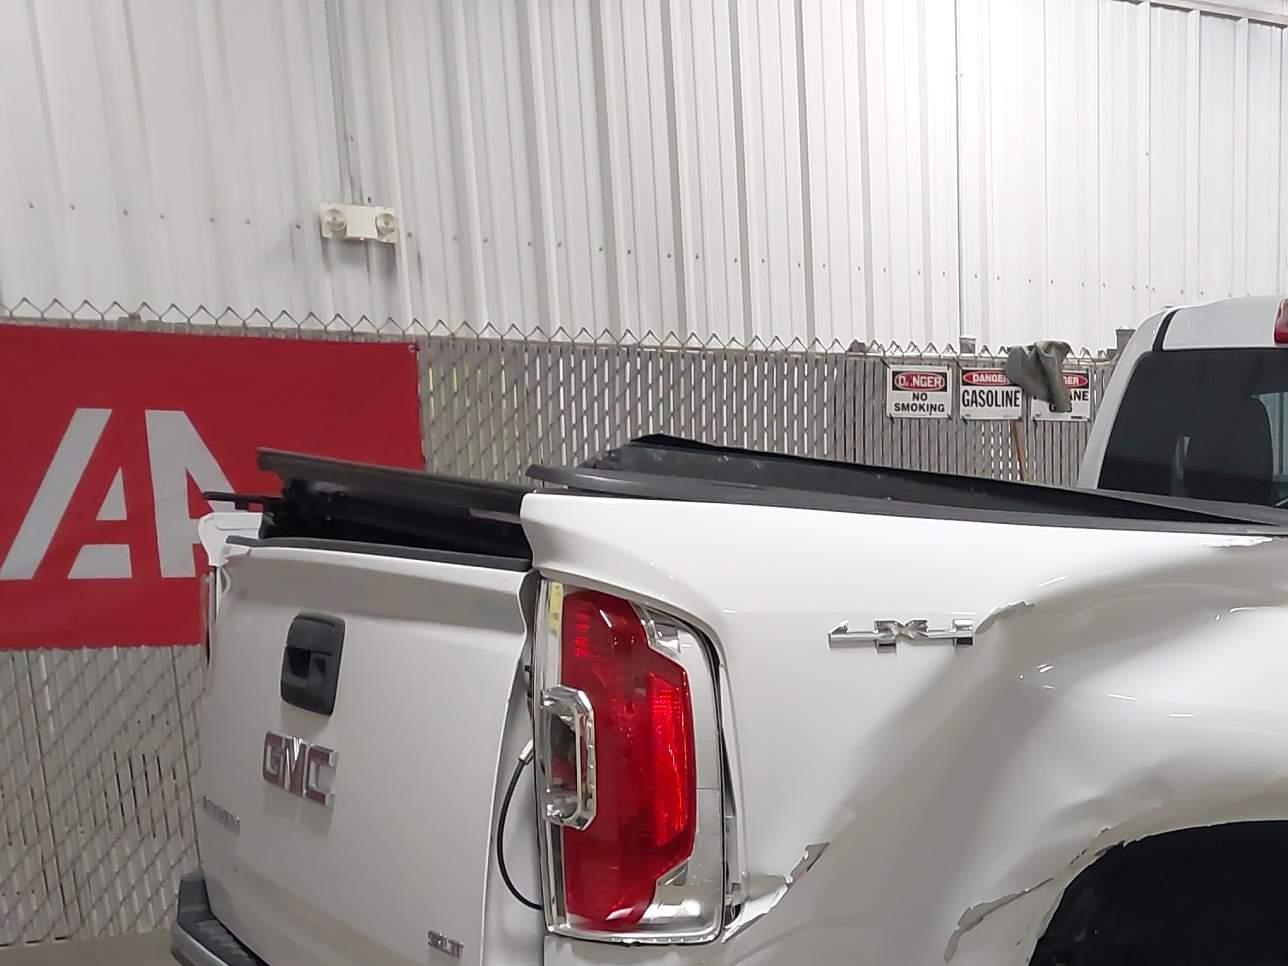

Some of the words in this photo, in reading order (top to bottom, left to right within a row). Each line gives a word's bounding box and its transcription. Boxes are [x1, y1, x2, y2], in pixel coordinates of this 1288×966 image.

[912, 392, 928, 401] NO
[962, 389, 1021, 408] GASOLINE
[894, 402, 945, 413] SMOKING
[262, 731, 338, 809] GMC
